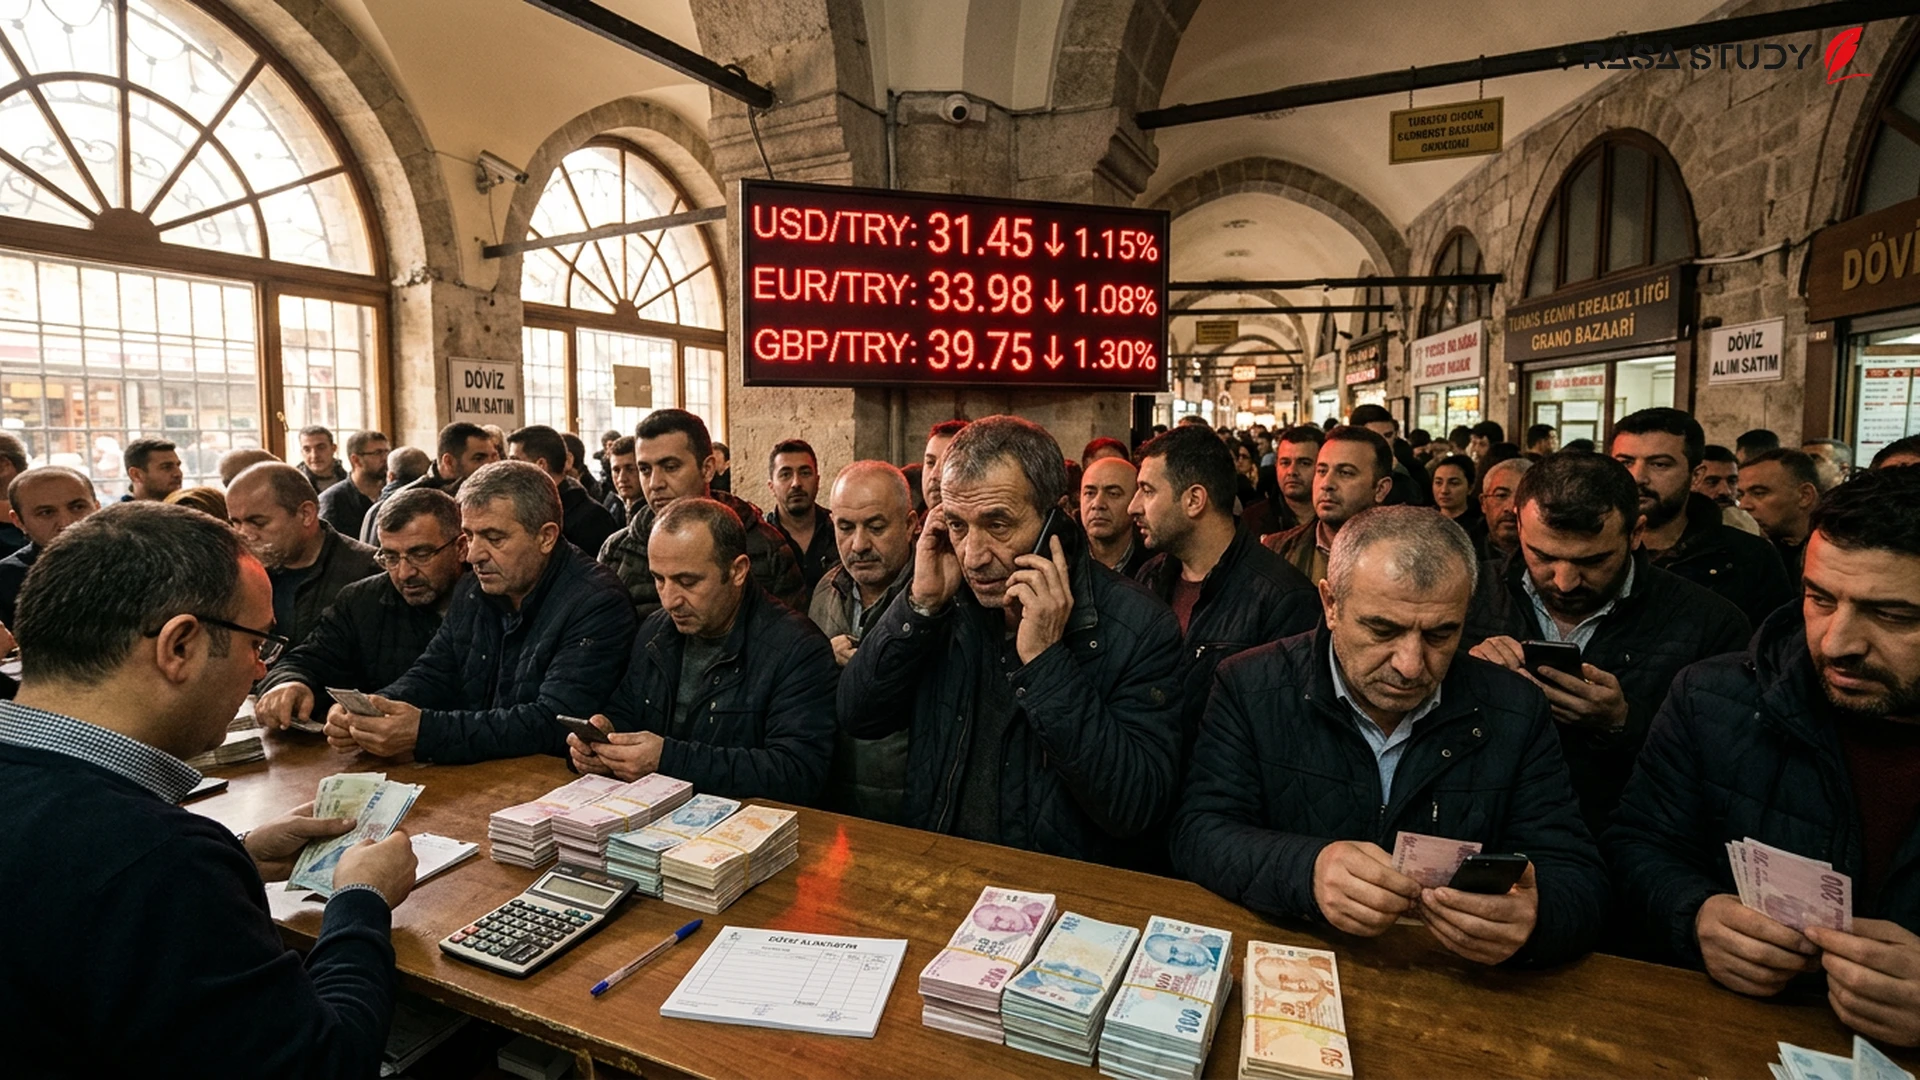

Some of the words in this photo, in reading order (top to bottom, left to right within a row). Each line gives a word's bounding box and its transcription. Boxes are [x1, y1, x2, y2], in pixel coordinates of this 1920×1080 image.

[754, 205, 917, 246] USD/TRY:
[928, 212, 1033, 258] 31.45
[1075, 228, 1158, 261] 1.15%
[754, 266, 916, 305] EUR/TRY:
[928, 270, 1033, 314] 33.98
[1075, 283, 1157, 316] 1.08%
[754, 328, 917, 364] GBP/TRY:
[928, 328, 1033, 371] 39.75
[1074, 338, 1156, 370] 1.30%
[1728, 328, 1763, 352] DÖVİZ
[1741, 354, 1778, 373] SATIM
